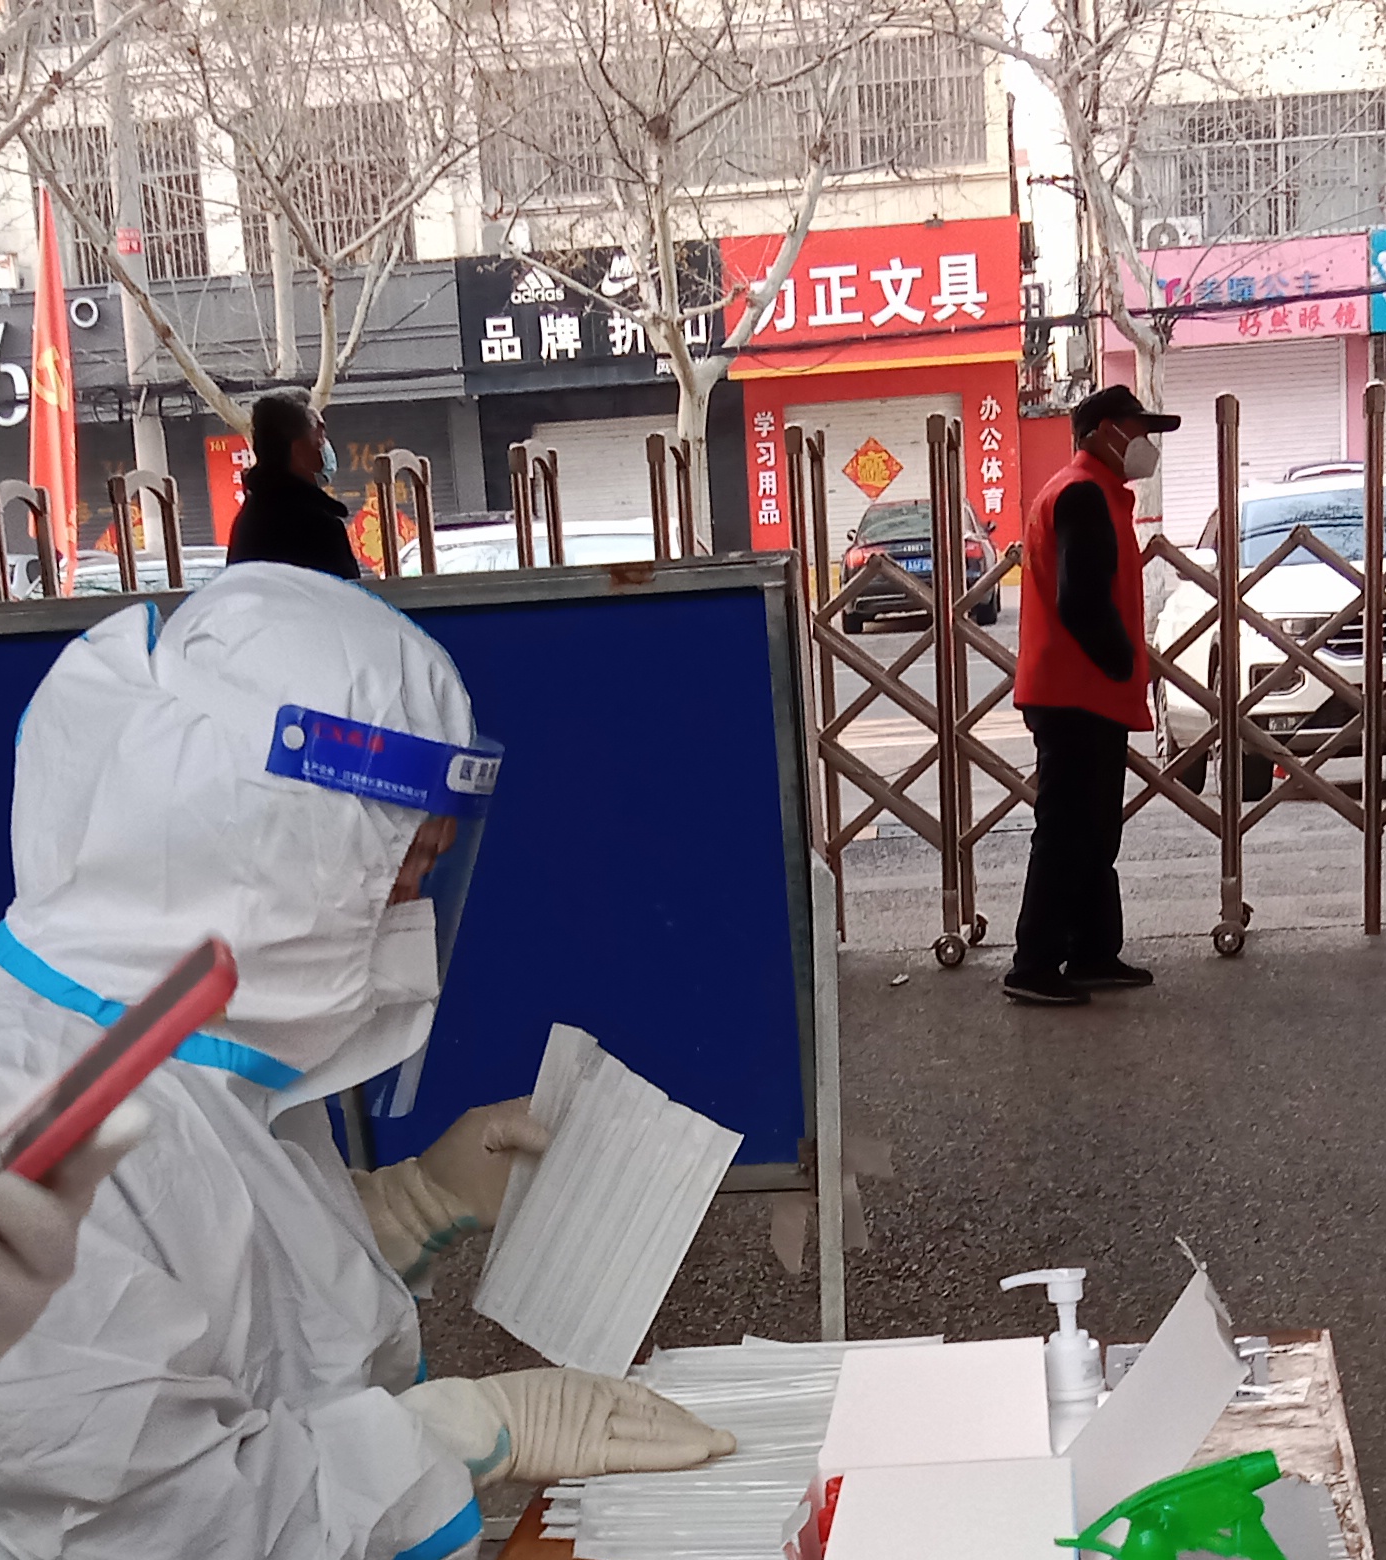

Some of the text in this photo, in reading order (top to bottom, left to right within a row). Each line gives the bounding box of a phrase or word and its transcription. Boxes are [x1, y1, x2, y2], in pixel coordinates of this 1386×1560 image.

[510, 286, 565, 305] adidas
[753, 411, 781, 525] 学习用品
[979, 394, 1005, 515] 办公体育
